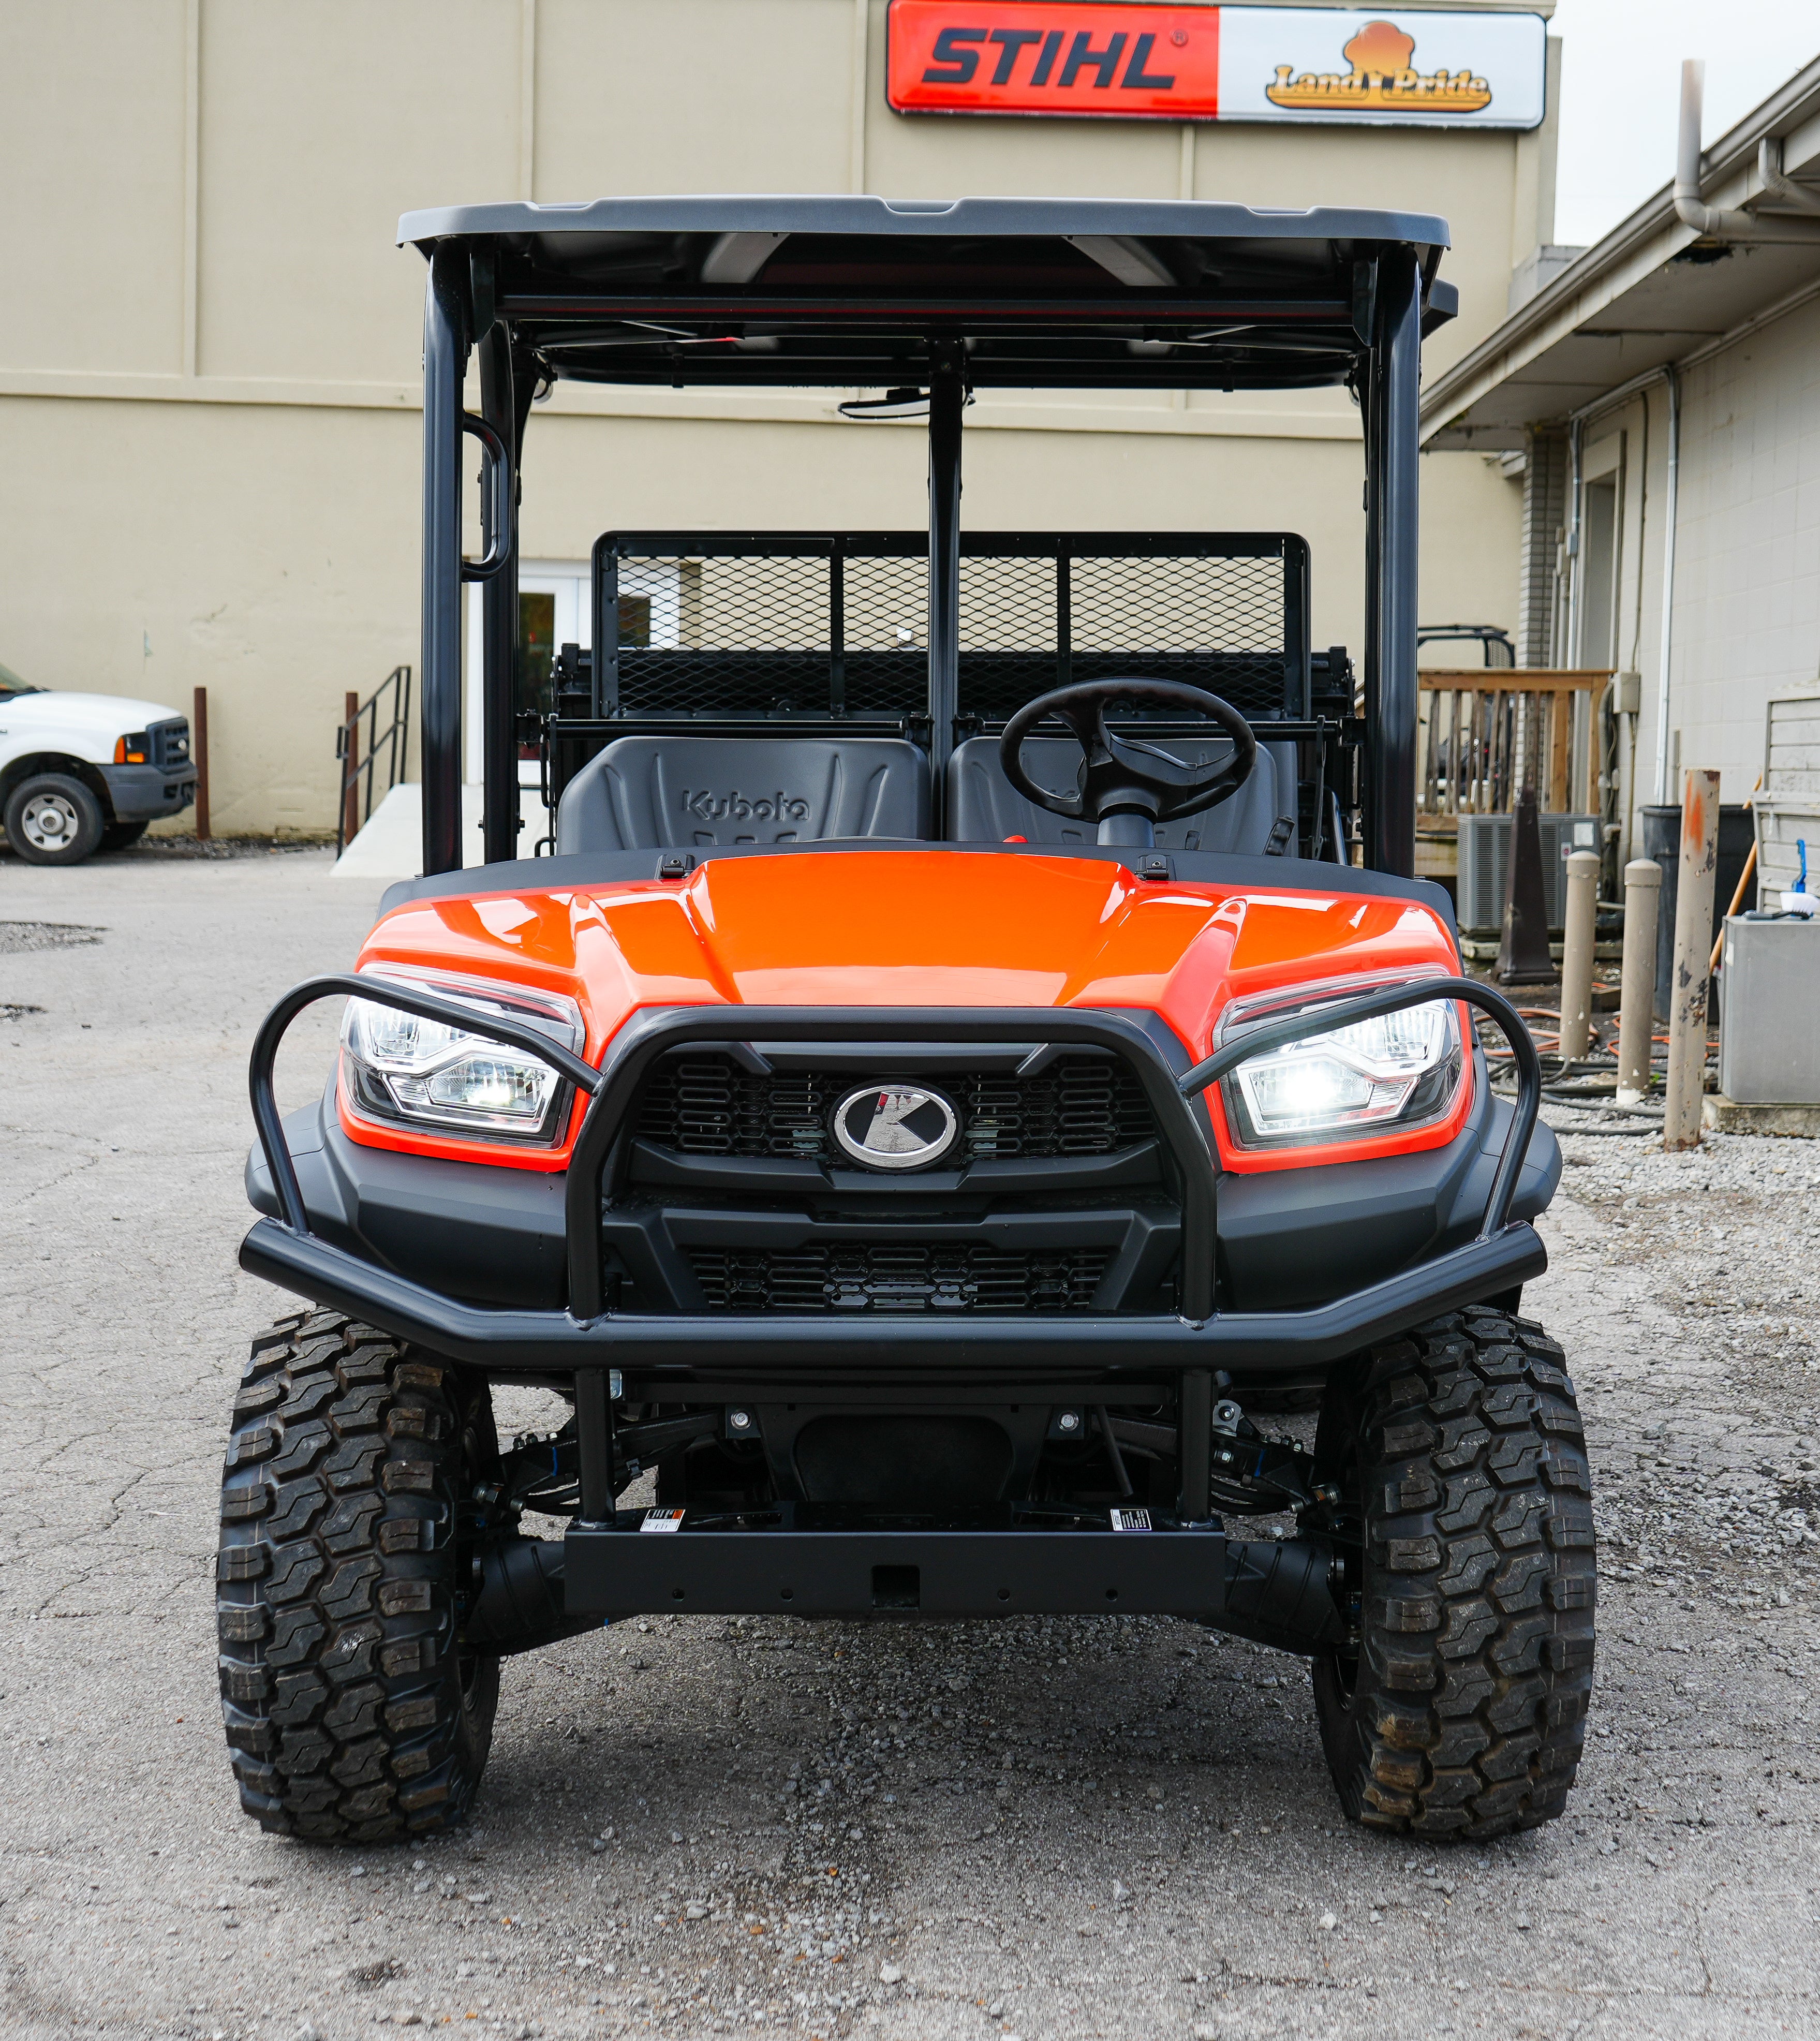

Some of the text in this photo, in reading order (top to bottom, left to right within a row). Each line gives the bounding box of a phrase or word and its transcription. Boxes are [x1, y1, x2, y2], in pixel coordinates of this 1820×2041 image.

[921, 27, 1176, 90] STIHL
[1268, 65, 1490, 98] Land Pride
[682, 789, 810, 821] Kubota
